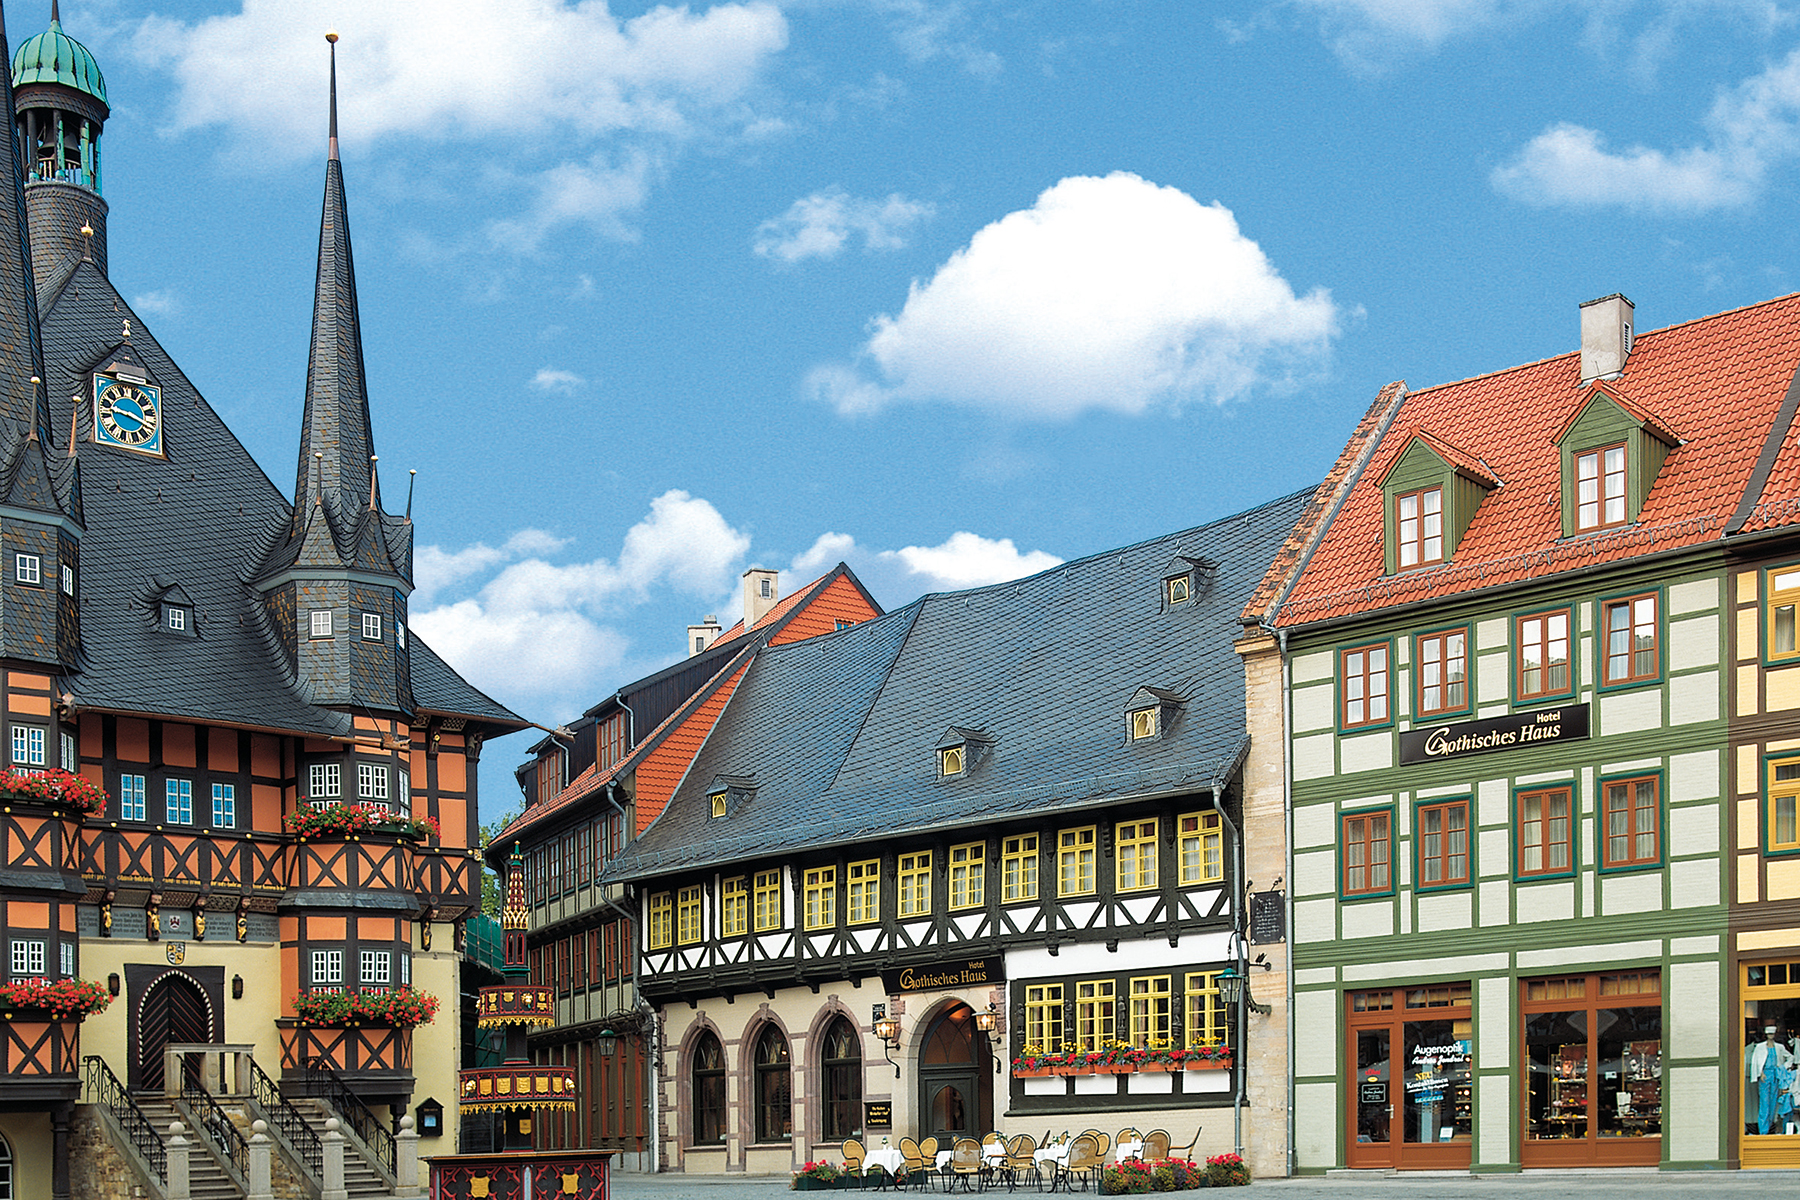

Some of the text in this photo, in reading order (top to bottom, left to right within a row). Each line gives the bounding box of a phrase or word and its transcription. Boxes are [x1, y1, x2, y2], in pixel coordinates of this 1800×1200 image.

[1536, 711, 1561, 723] Hotel
[1424, 724, 1561, 756] Gothisches Haus
[968, 961, 985, 970] Hotel
[900, 968, 987, 990] Gothisches Haus
[1413, 1041, 1464, 1056] Augenoptik
[1415, 1071, 1433, 1081] NEU
